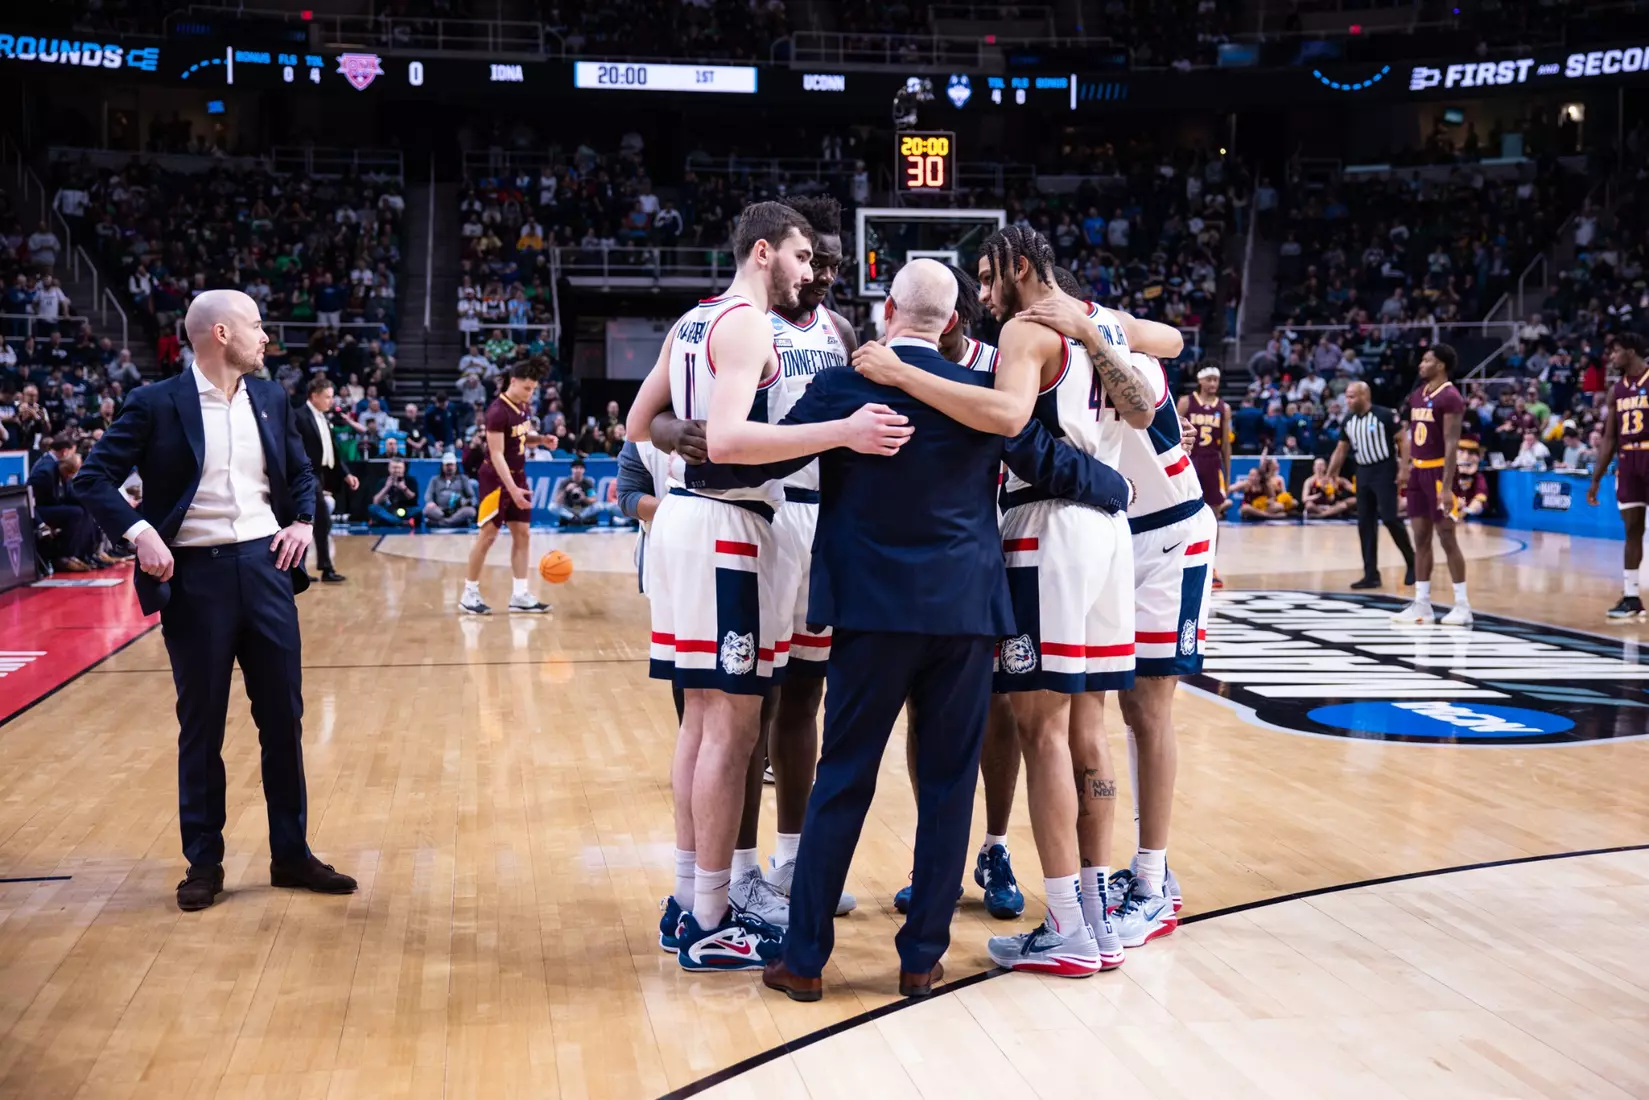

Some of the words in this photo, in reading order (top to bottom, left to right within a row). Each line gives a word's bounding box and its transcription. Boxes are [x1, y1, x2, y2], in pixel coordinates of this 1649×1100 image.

[408, 61, 424, 86] 0
[490, 64, 524, 82] IONA
[598, 66, 647, 85] 20:00
[695, 70, 715, 84] 1ST
[803, 74, 845, 92] UCONN
[1444, 58, 1535, 88] FIRST
[901, 137, 949, 156] 20:00
[907, 155, 944, 187] 30
[684, 353, 697, 419] 11
[1414, 421, 1427, 446] 0
[1621, 410, 1644, 435] 13
[1199, 425, 1212, 446] 5
